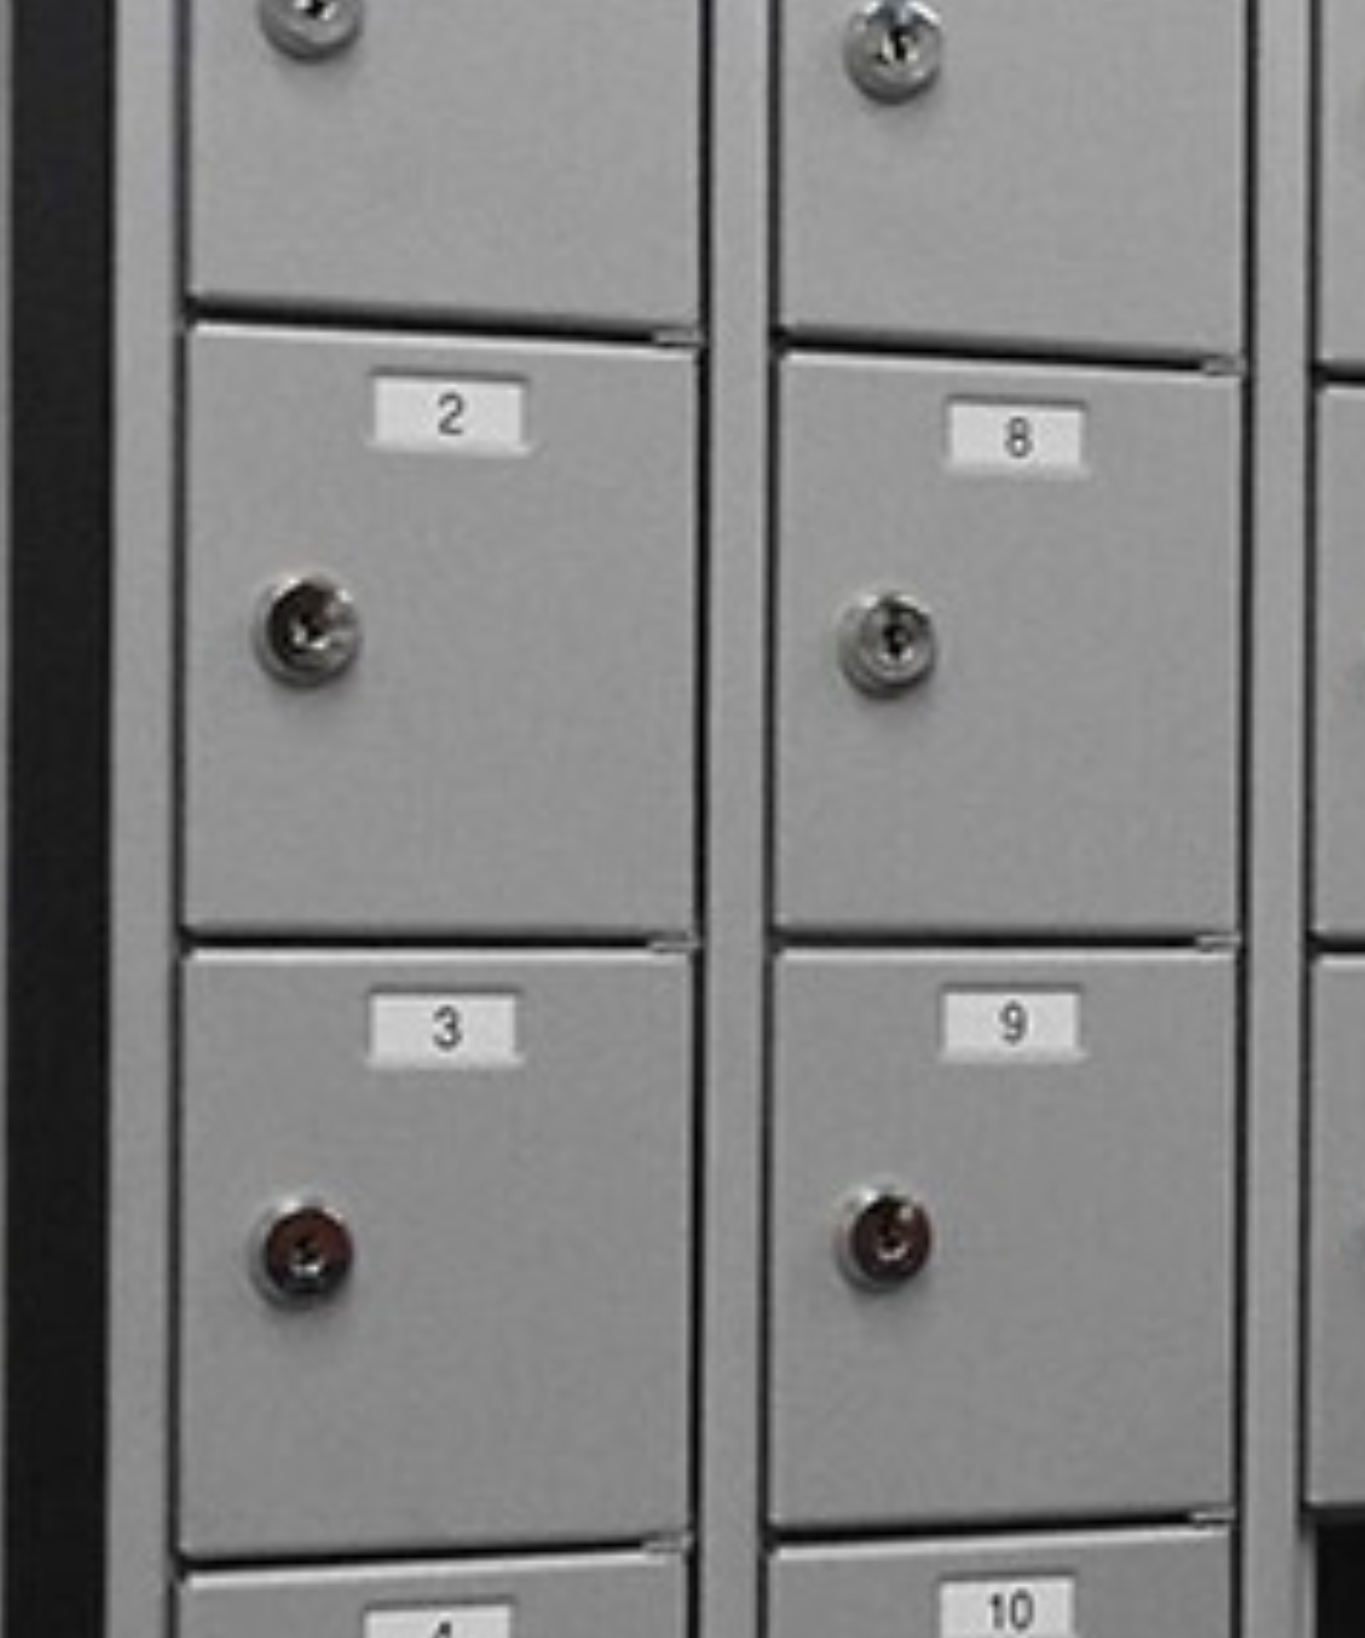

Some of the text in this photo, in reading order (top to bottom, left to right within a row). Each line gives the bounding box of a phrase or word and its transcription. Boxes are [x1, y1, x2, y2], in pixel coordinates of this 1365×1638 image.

[438, 391, 464, 437] 2
[1005, 416, 1032, 459] 8
[434, 1005, 462, 1051] 3
[999, 1000, 1027, 1045] 9
[990, 1590, 1034, 1631] 10
